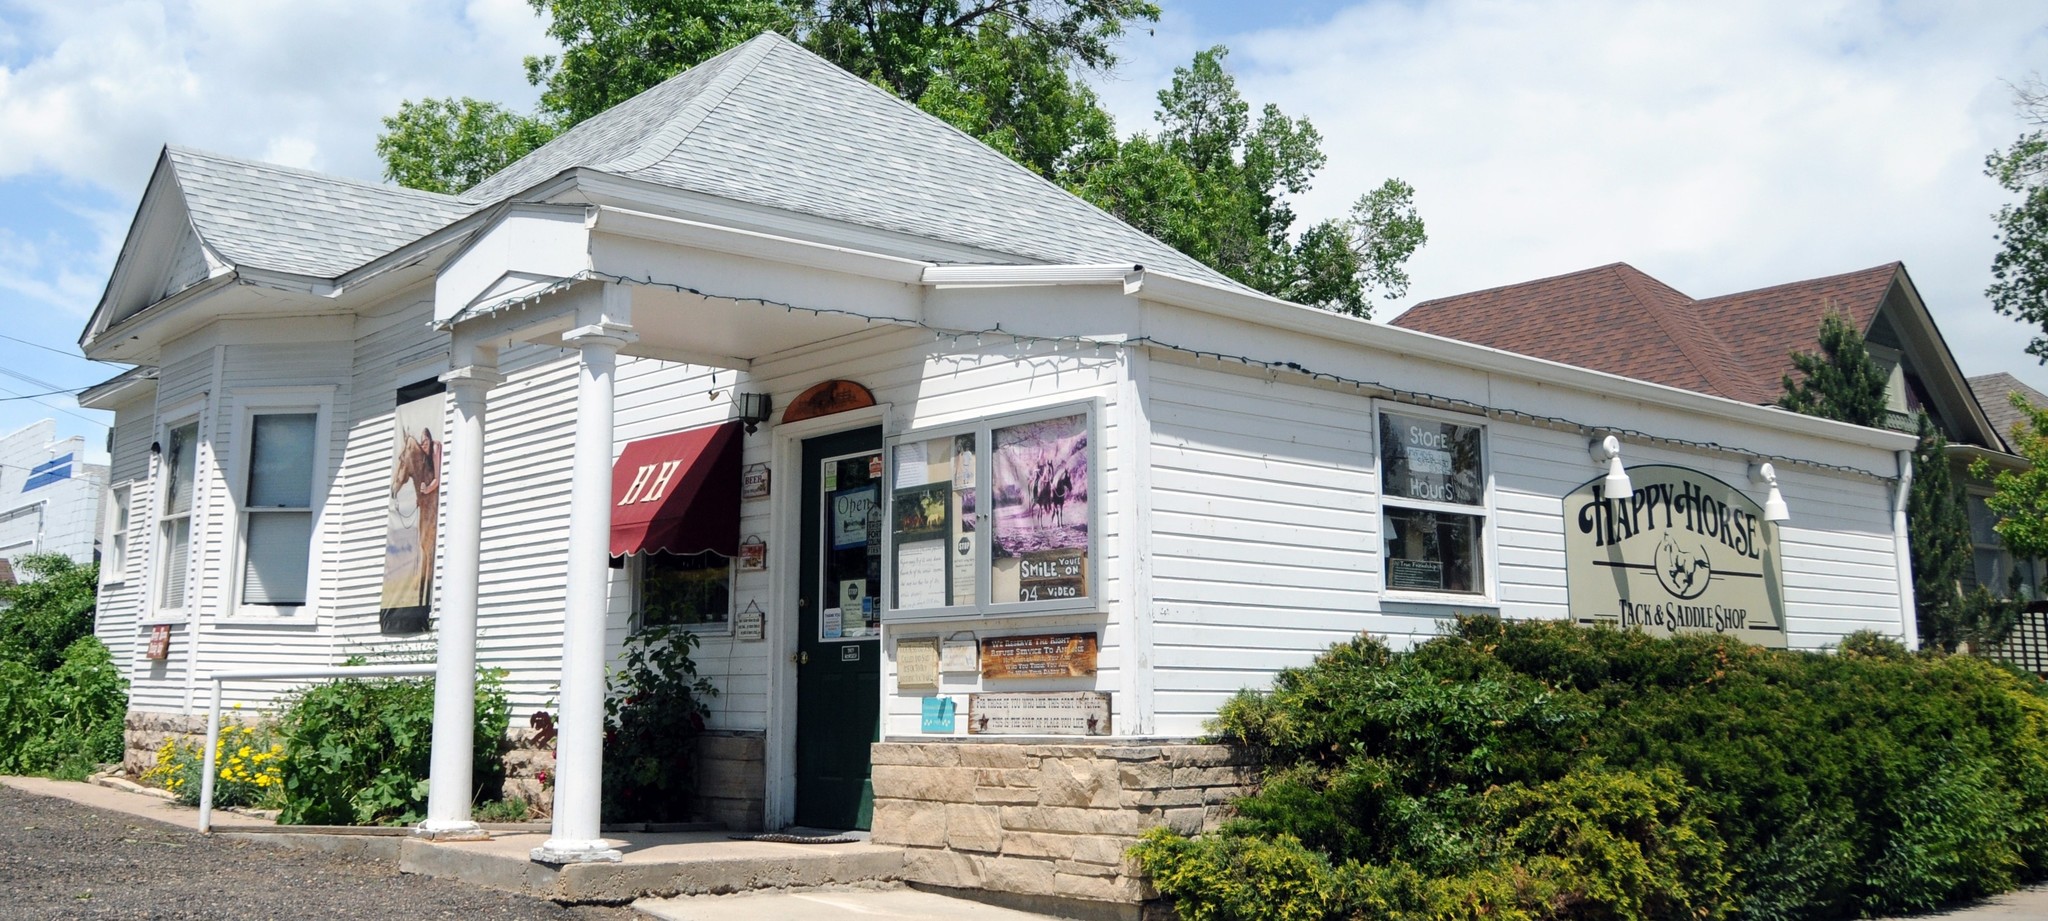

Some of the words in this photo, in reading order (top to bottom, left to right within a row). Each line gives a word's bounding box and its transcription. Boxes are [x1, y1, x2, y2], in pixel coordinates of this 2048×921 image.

[745, 474, 762, 485] BEER
[838, 496, 870, 518] Open
[1578, 484, 1674, 547] HAPPY
[1674, 480, 1760, 560] HORSE
[958, 542, 970, 551] STOP
[1065, 565, 1079, 575] ON
[1020, 586, 1038, 602] 24
[1047, 586, 1076, 597] ViDEO
[1619, 599, 1651, 628] TACK
[1654, 604, 1664, 626] &
[1666, 602, 1714, 632] SADDLE
[1715, 604, 1747, 633] SHOP
[1005, 639, 1032, 648] RESERVE
[991, 649, 1014, 657] REFUSE
[1015, 647, 1042, 656] SERVICE
[1043, 646, 1053, 654] TO
[1055, 645, 1085, 654] ANNE
